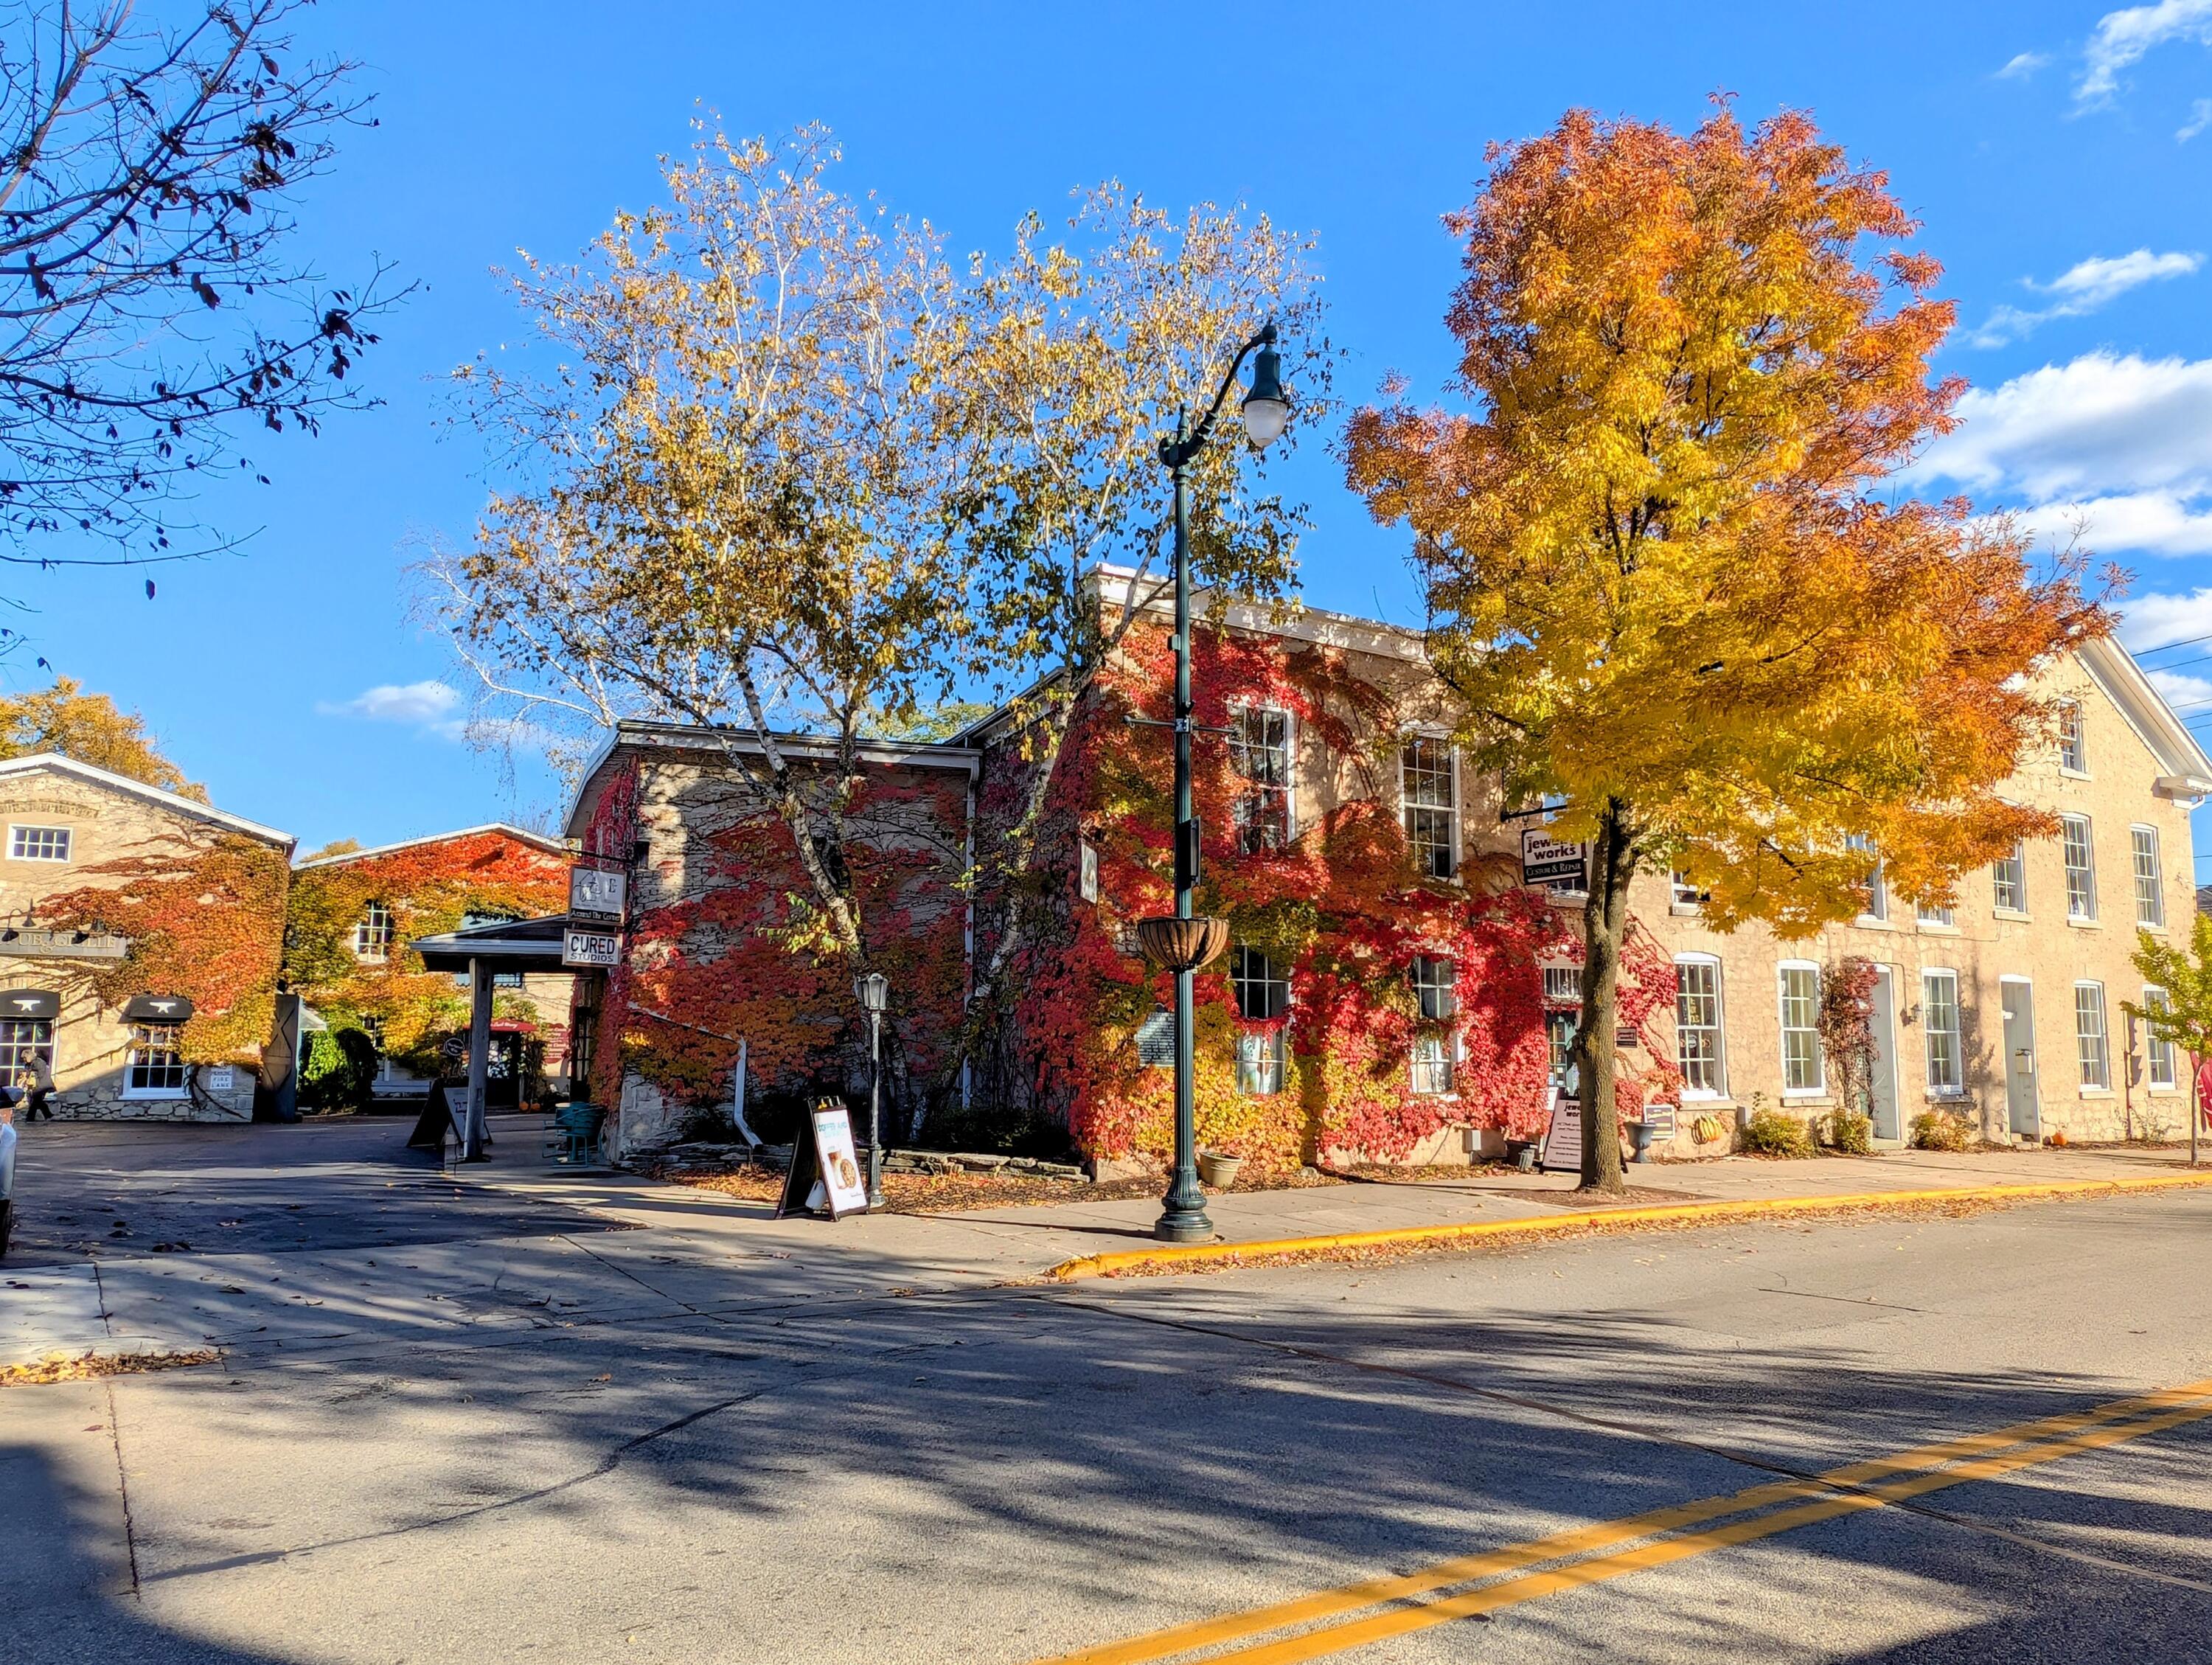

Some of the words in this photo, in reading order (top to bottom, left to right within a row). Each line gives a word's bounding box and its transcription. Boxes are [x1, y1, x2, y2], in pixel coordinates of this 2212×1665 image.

[1526, 836, 1576, 853] jewe
[1534, 845, 1576, 861] works
[1551, 864, 1558, 873] &
[54, 934, 116, 948] GLLE
[571, 935, 615, 954] CURED
[571, 952, 614, 962] STUDIOS
